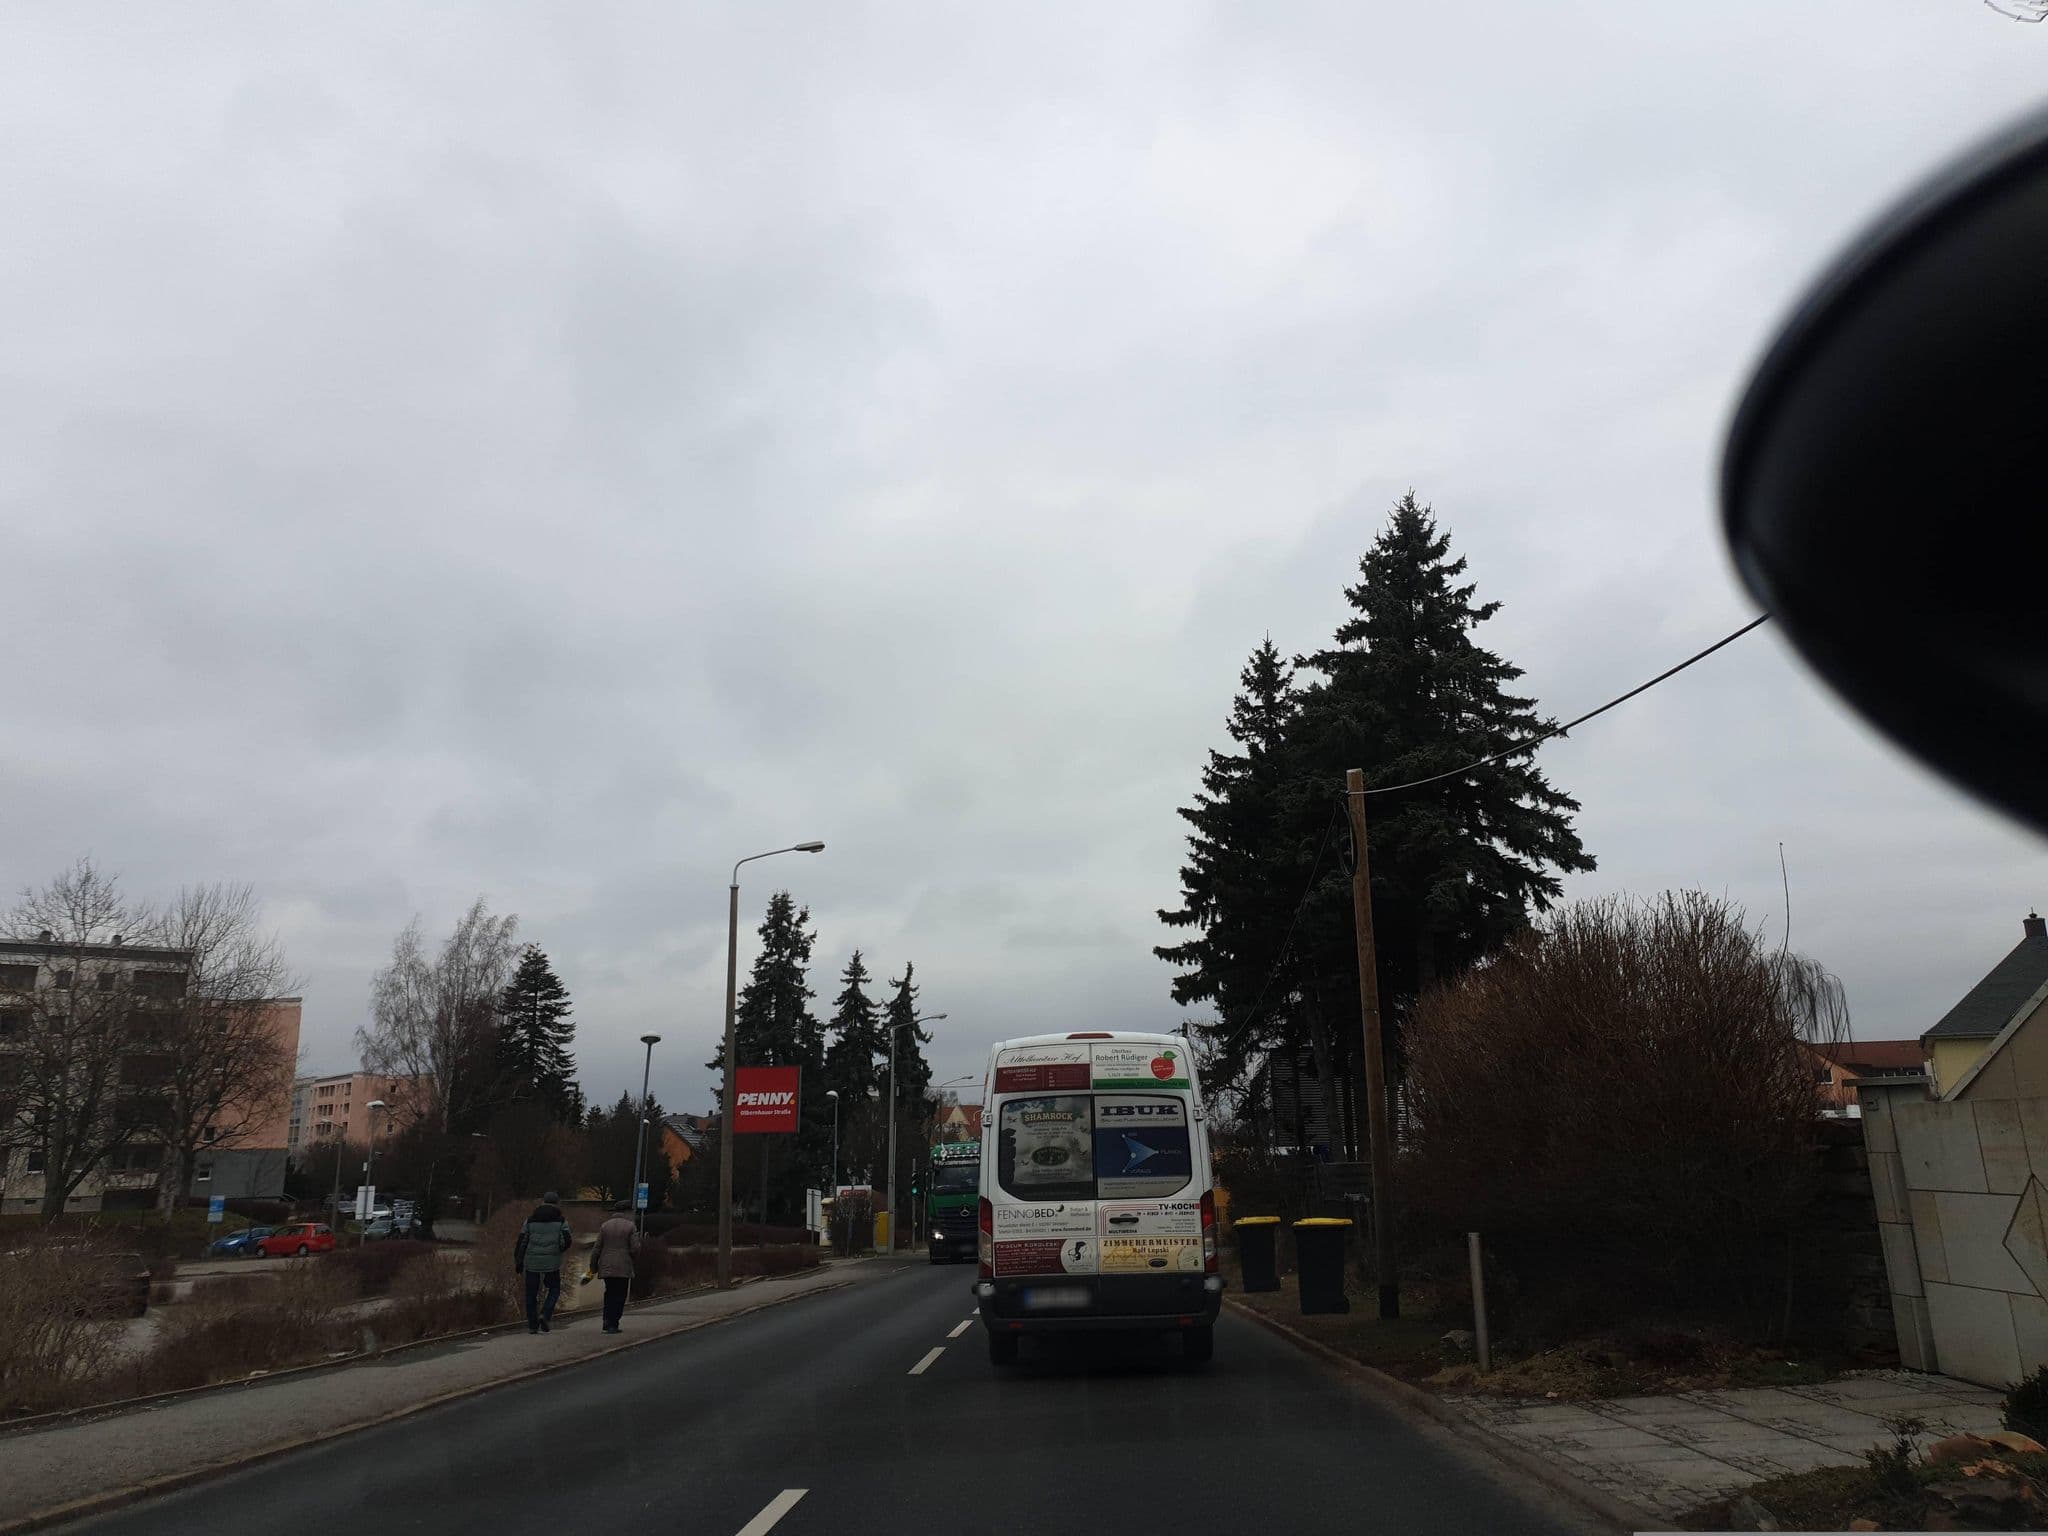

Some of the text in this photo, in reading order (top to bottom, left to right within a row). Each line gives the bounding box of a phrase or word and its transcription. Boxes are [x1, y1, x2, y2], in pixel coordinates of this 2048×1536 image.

[1121, 1054, 1148, 1062] Rüdiger
[1101, 1105, 1178, 1116] IBUK
[1024, 1112, 1073, 1121] SHAMROCK
[997, 1208, 1055, 1220] FENNOBED
